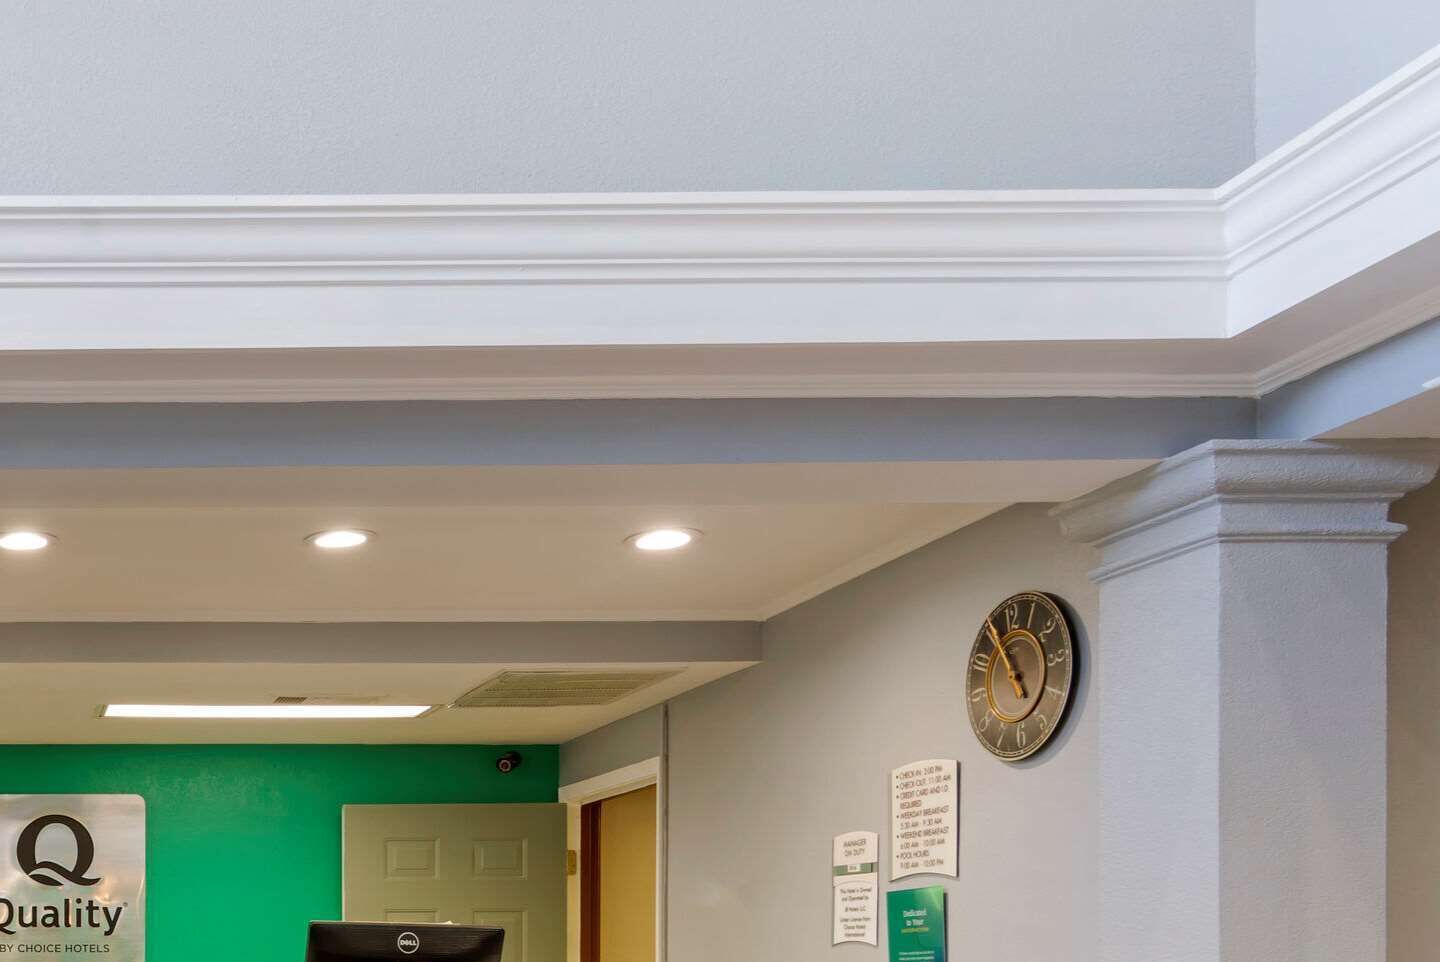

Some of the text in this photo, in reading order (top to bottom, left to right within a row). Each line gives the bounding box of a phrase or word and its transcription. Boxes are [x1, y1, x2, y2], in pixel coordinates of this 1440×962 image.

[1003, 604, 1020, 632] 12
[973, 653, 990, 672] 10
[0, 944, 110, 953] BY CHOICE HOTELS
